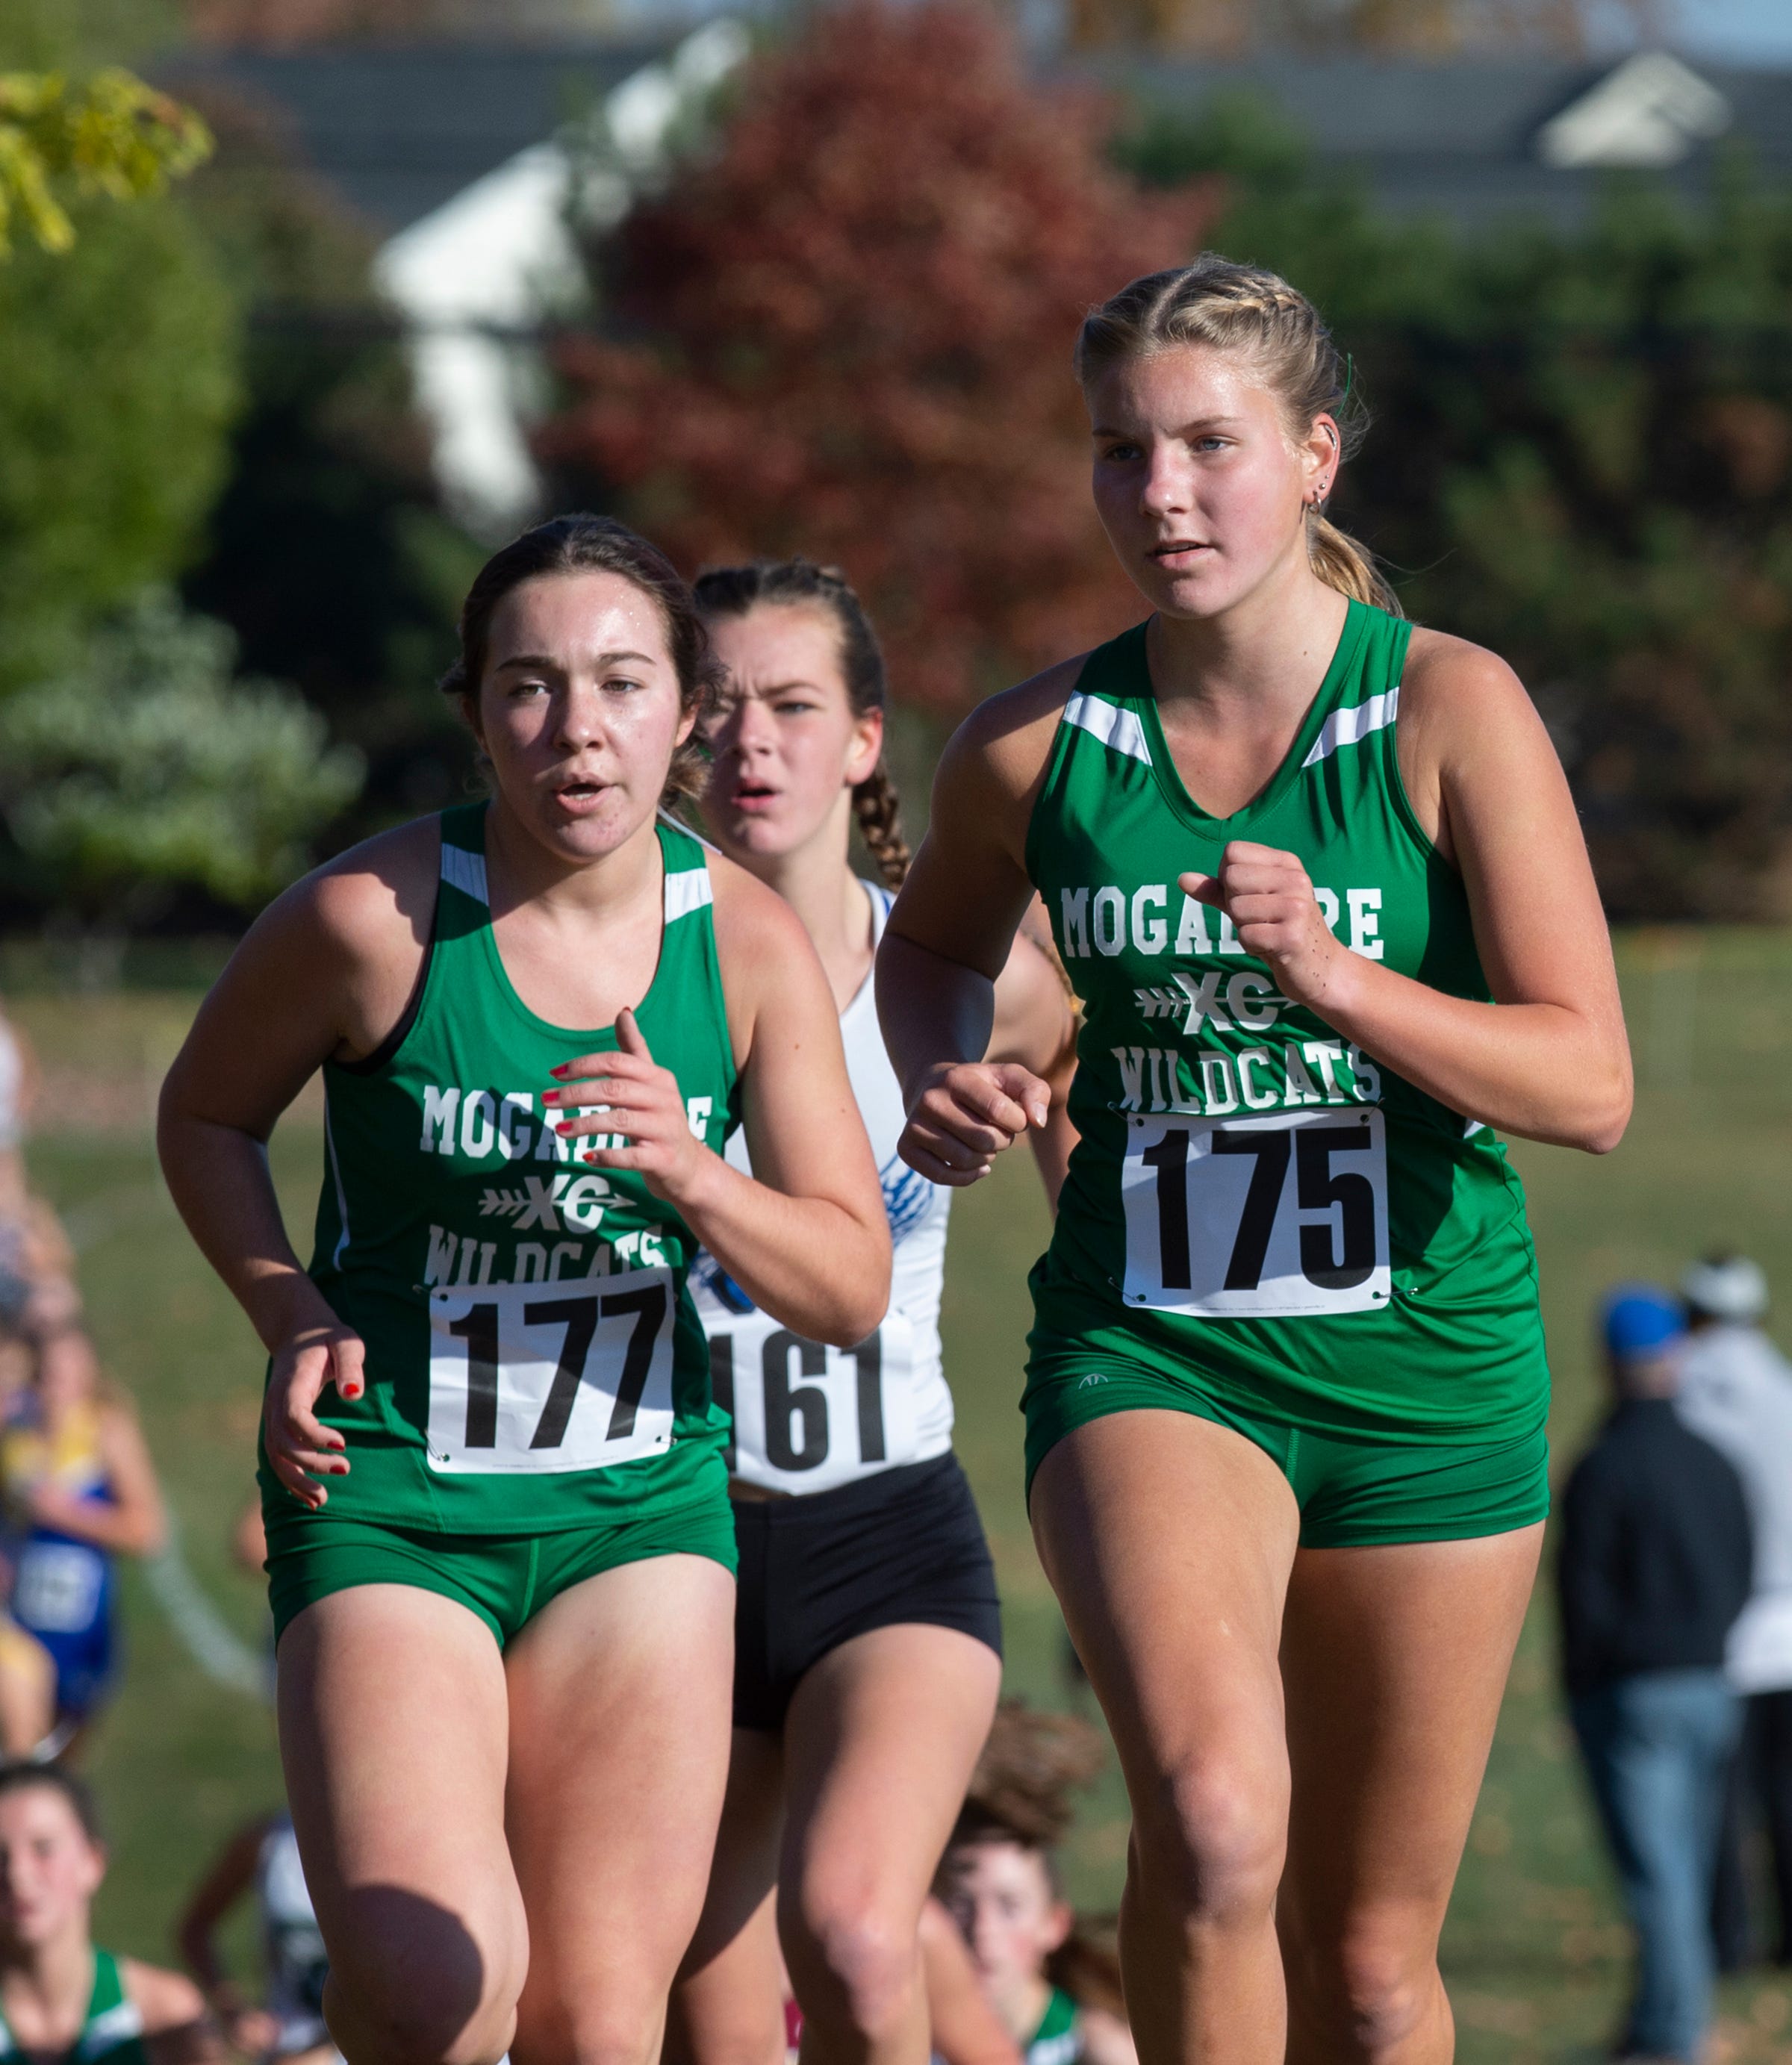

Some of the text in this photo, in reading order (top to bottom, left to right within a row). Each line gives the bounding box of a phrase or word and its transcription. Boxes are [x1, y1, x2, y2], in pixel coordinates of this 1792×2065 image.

[1061, 885, 1384, 959] MOGAE
[1171, 971, 1278, 1035] XC
[1110, 1039, 1381, 1115] WILDCATS
[420, 1085, 712, 1162] MOGADE
[511, 1174, 610, 1234] XC
[1142, 1126, 1377, 1291] 175
[424, 1224, 671, 1286] WILDCATS
[449, 1284, 666, 1449] 177
